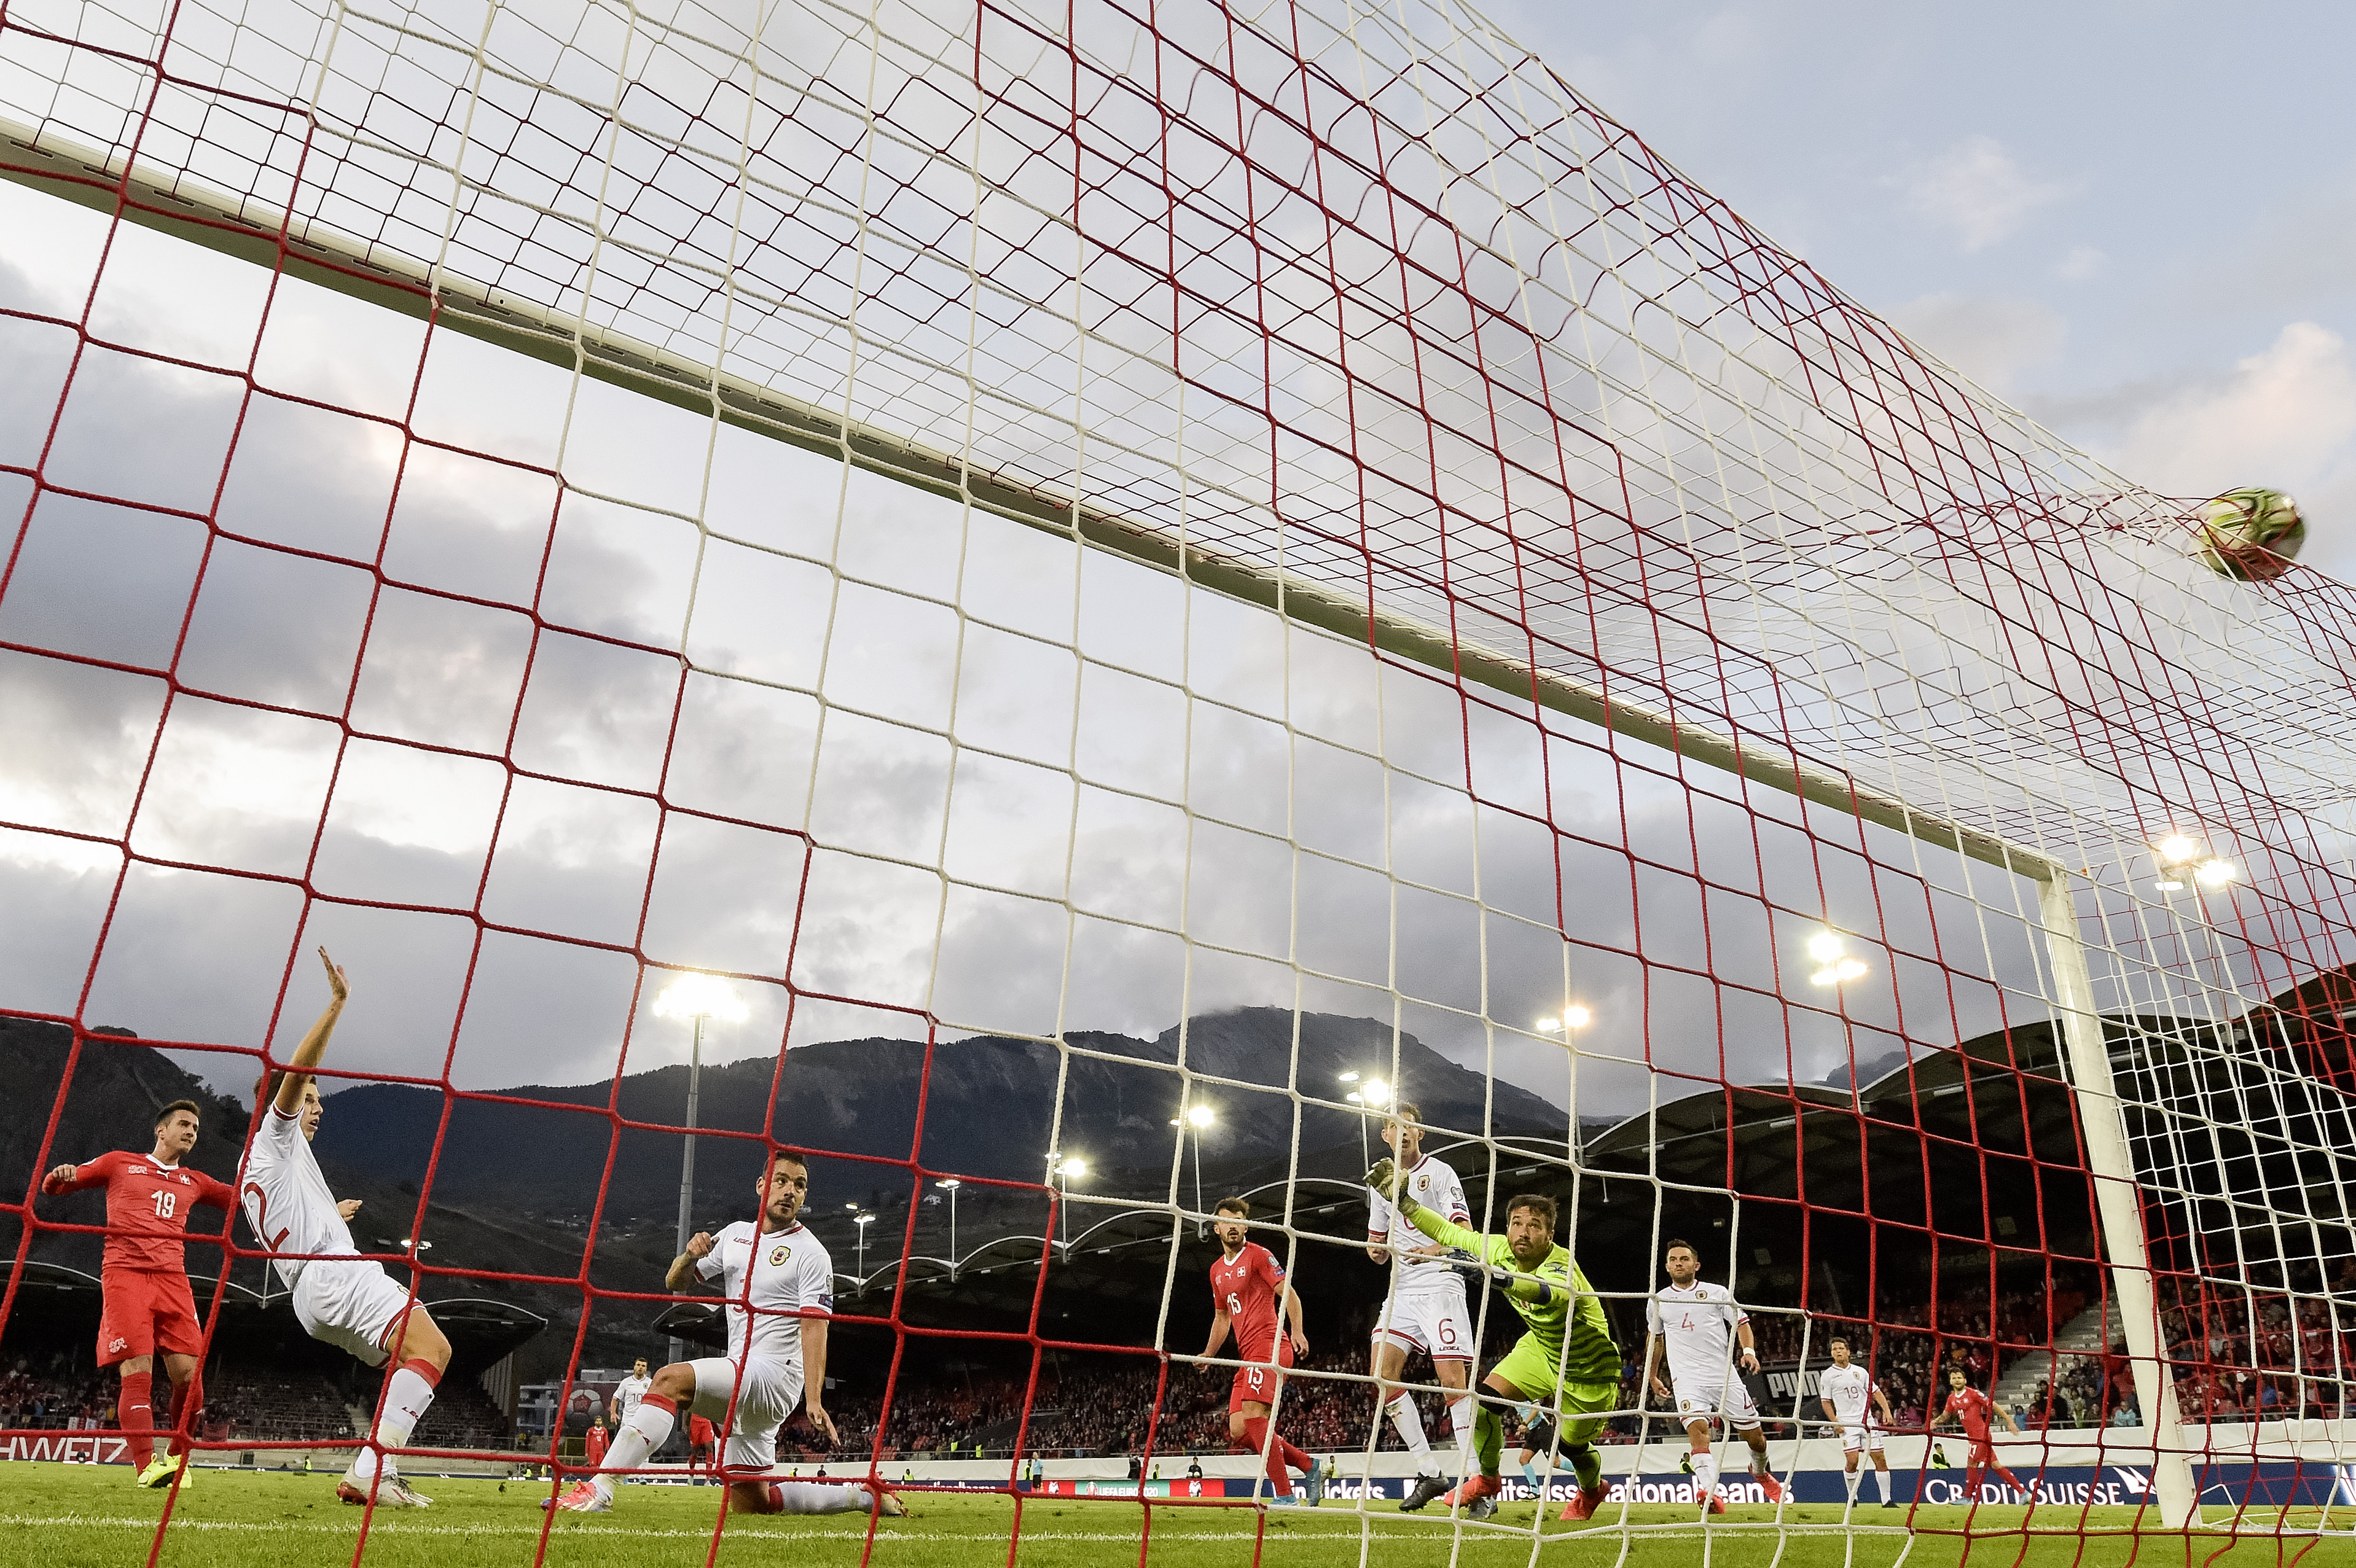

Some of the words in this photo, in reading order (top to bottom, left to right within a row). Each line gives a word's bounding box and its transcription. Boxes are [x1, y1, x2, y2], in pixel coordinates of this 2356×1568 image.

[151, 1190, 176, 1218] 19
[734, 1237, 753, 1246] LEGEA
[1227, 1292, 1242, 1315] 15
[1681, 1313, 1694, 1332] 4
[1438, 1319, 1456, 1344] 6
[632, 1393, 643, 1403] 10
[1844, 1386, 1858, 1398] 19
[1957, 1409, 1965, 1420] 11
[1099, 1487, 1118, 1496] UEFA
[1118, 1487, 1138, 1497] EURO
[1143, 1487, 1159, 1497] 020
[2029, 1478, 2124, 1505] SUISSE
